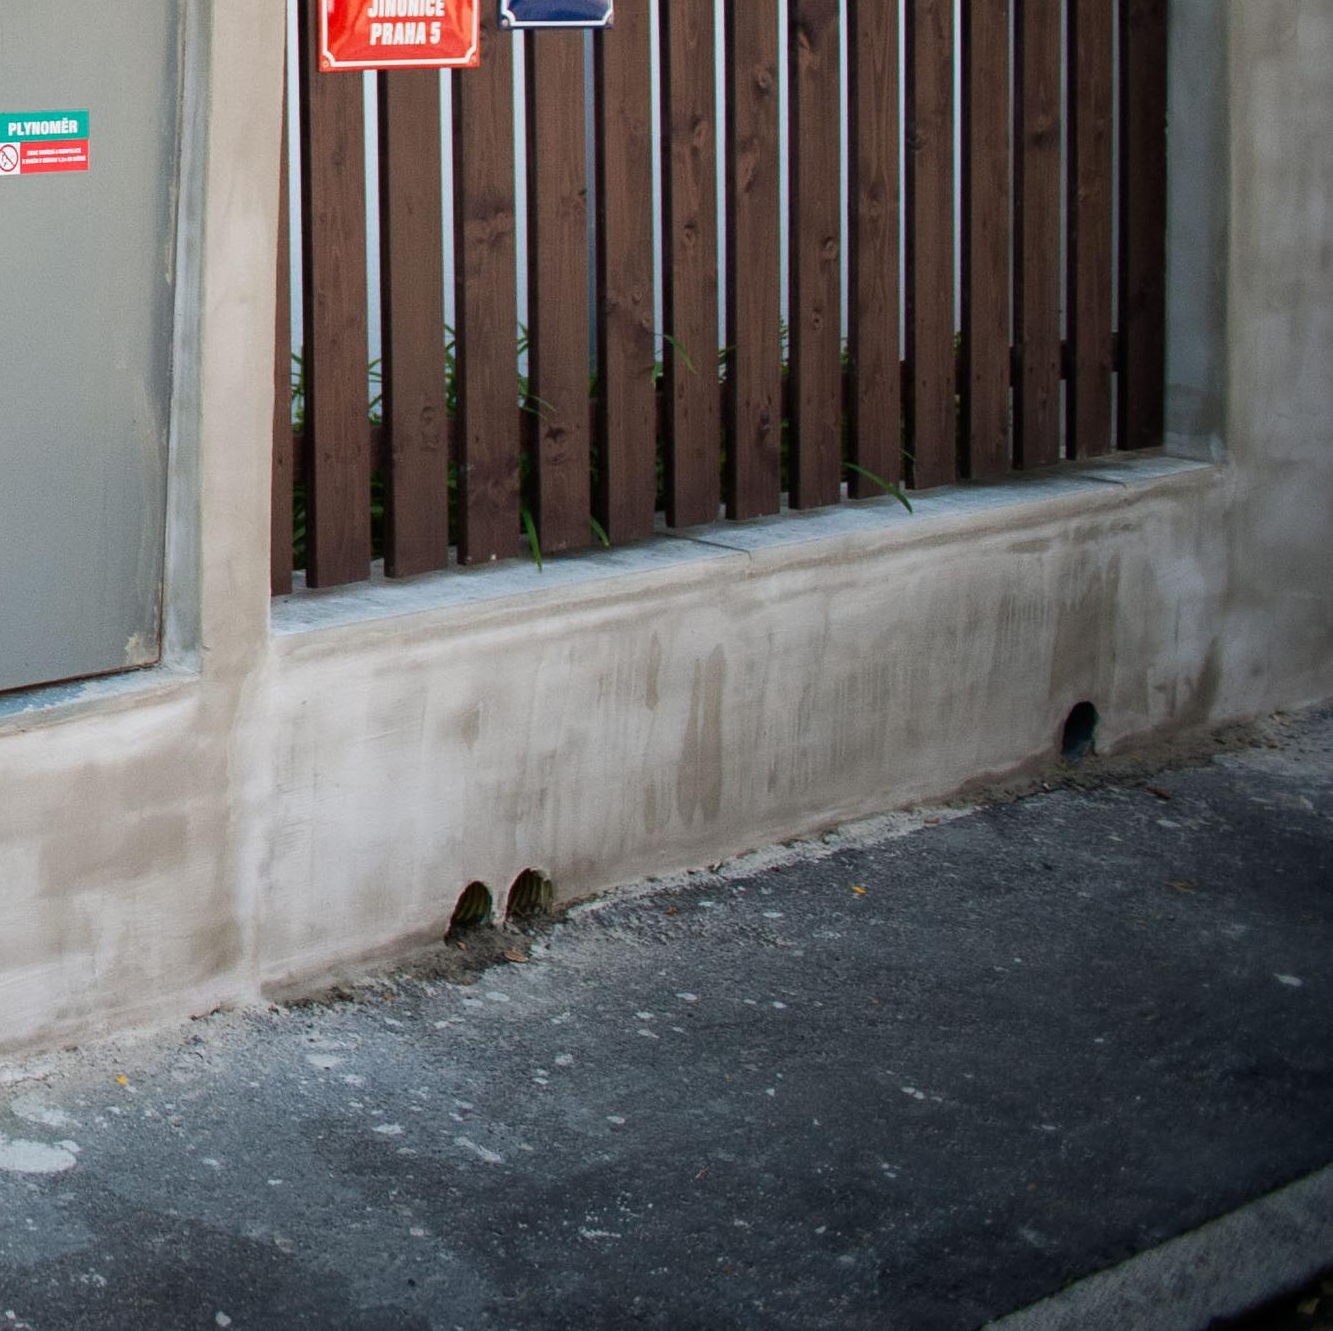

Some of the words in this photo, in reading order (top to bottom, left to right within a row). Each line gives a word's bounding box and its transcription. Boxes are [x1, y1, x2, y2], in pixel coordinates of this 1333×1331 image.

[369, 22, 427, 46] PRAHA
[430, 21, 441, 45] 5
[8, 118, 78, 136] PLYNOMĚR
